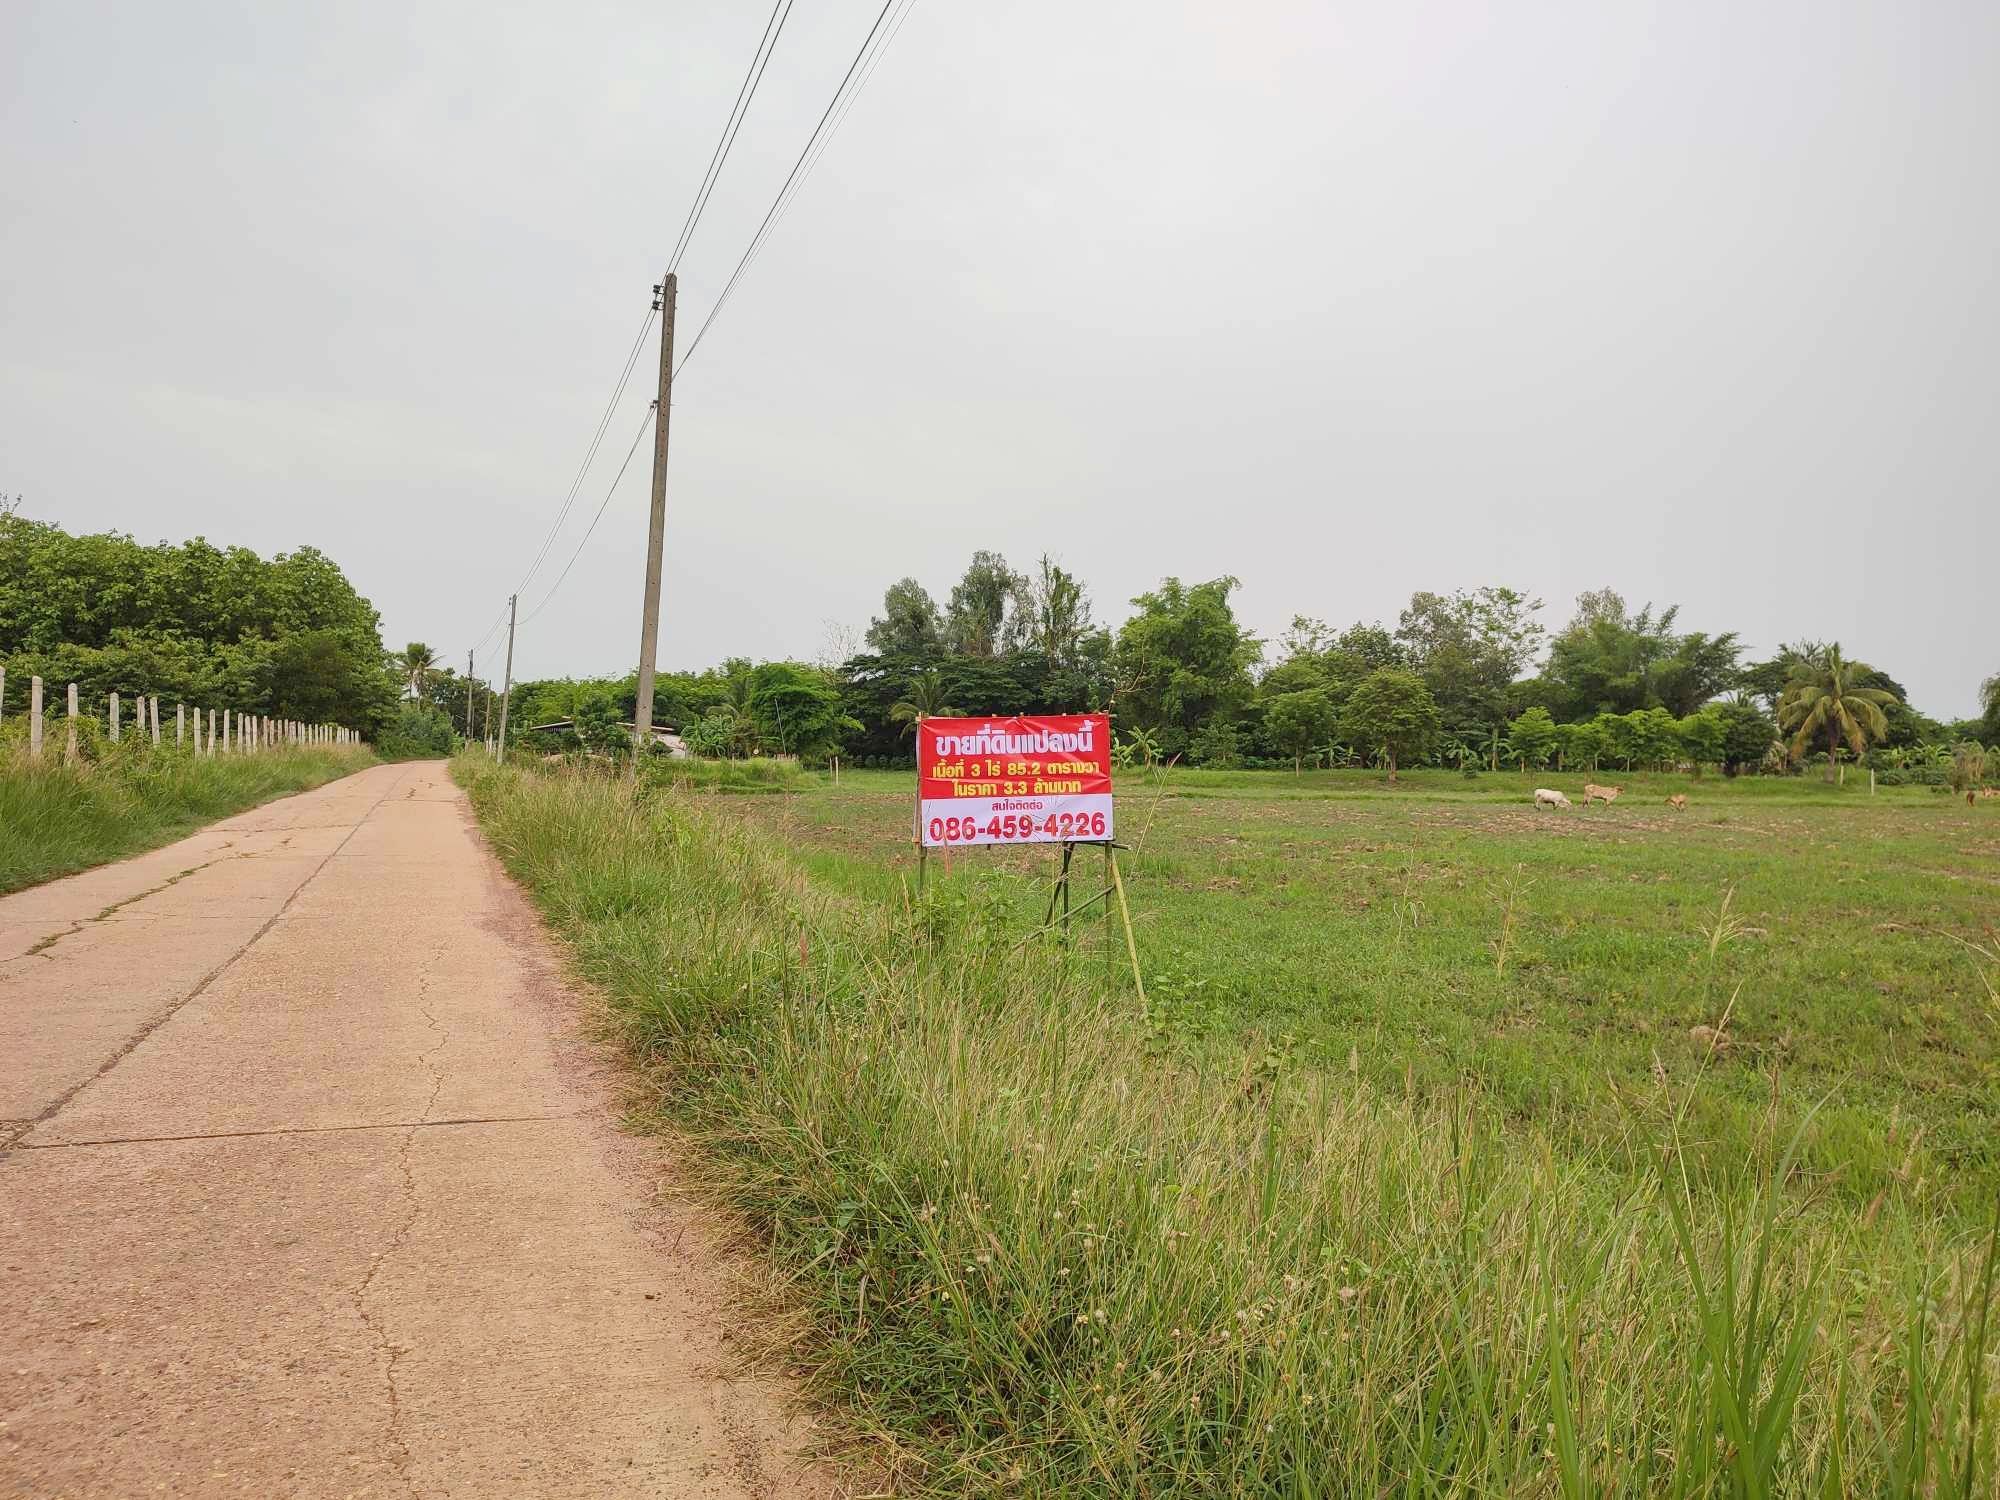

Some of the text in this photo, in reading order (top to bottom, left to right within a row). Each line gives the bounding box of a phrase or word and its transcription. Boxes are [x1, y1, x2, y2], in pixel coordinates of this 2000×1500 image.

[936, 720, 1093, 756] ขายที่ดินแปลงนี้
[932, 758, 1100, 778] เนื้อที่ 3 ไร่ 85.2 ตารางวา
[952, 778, 1081, 796] ในราคา 3.3 ล้านบาท
[991, 798, 1043, 811] สนใจติดต่อ
[929, 812, 1106, 842] 086-459-4226
